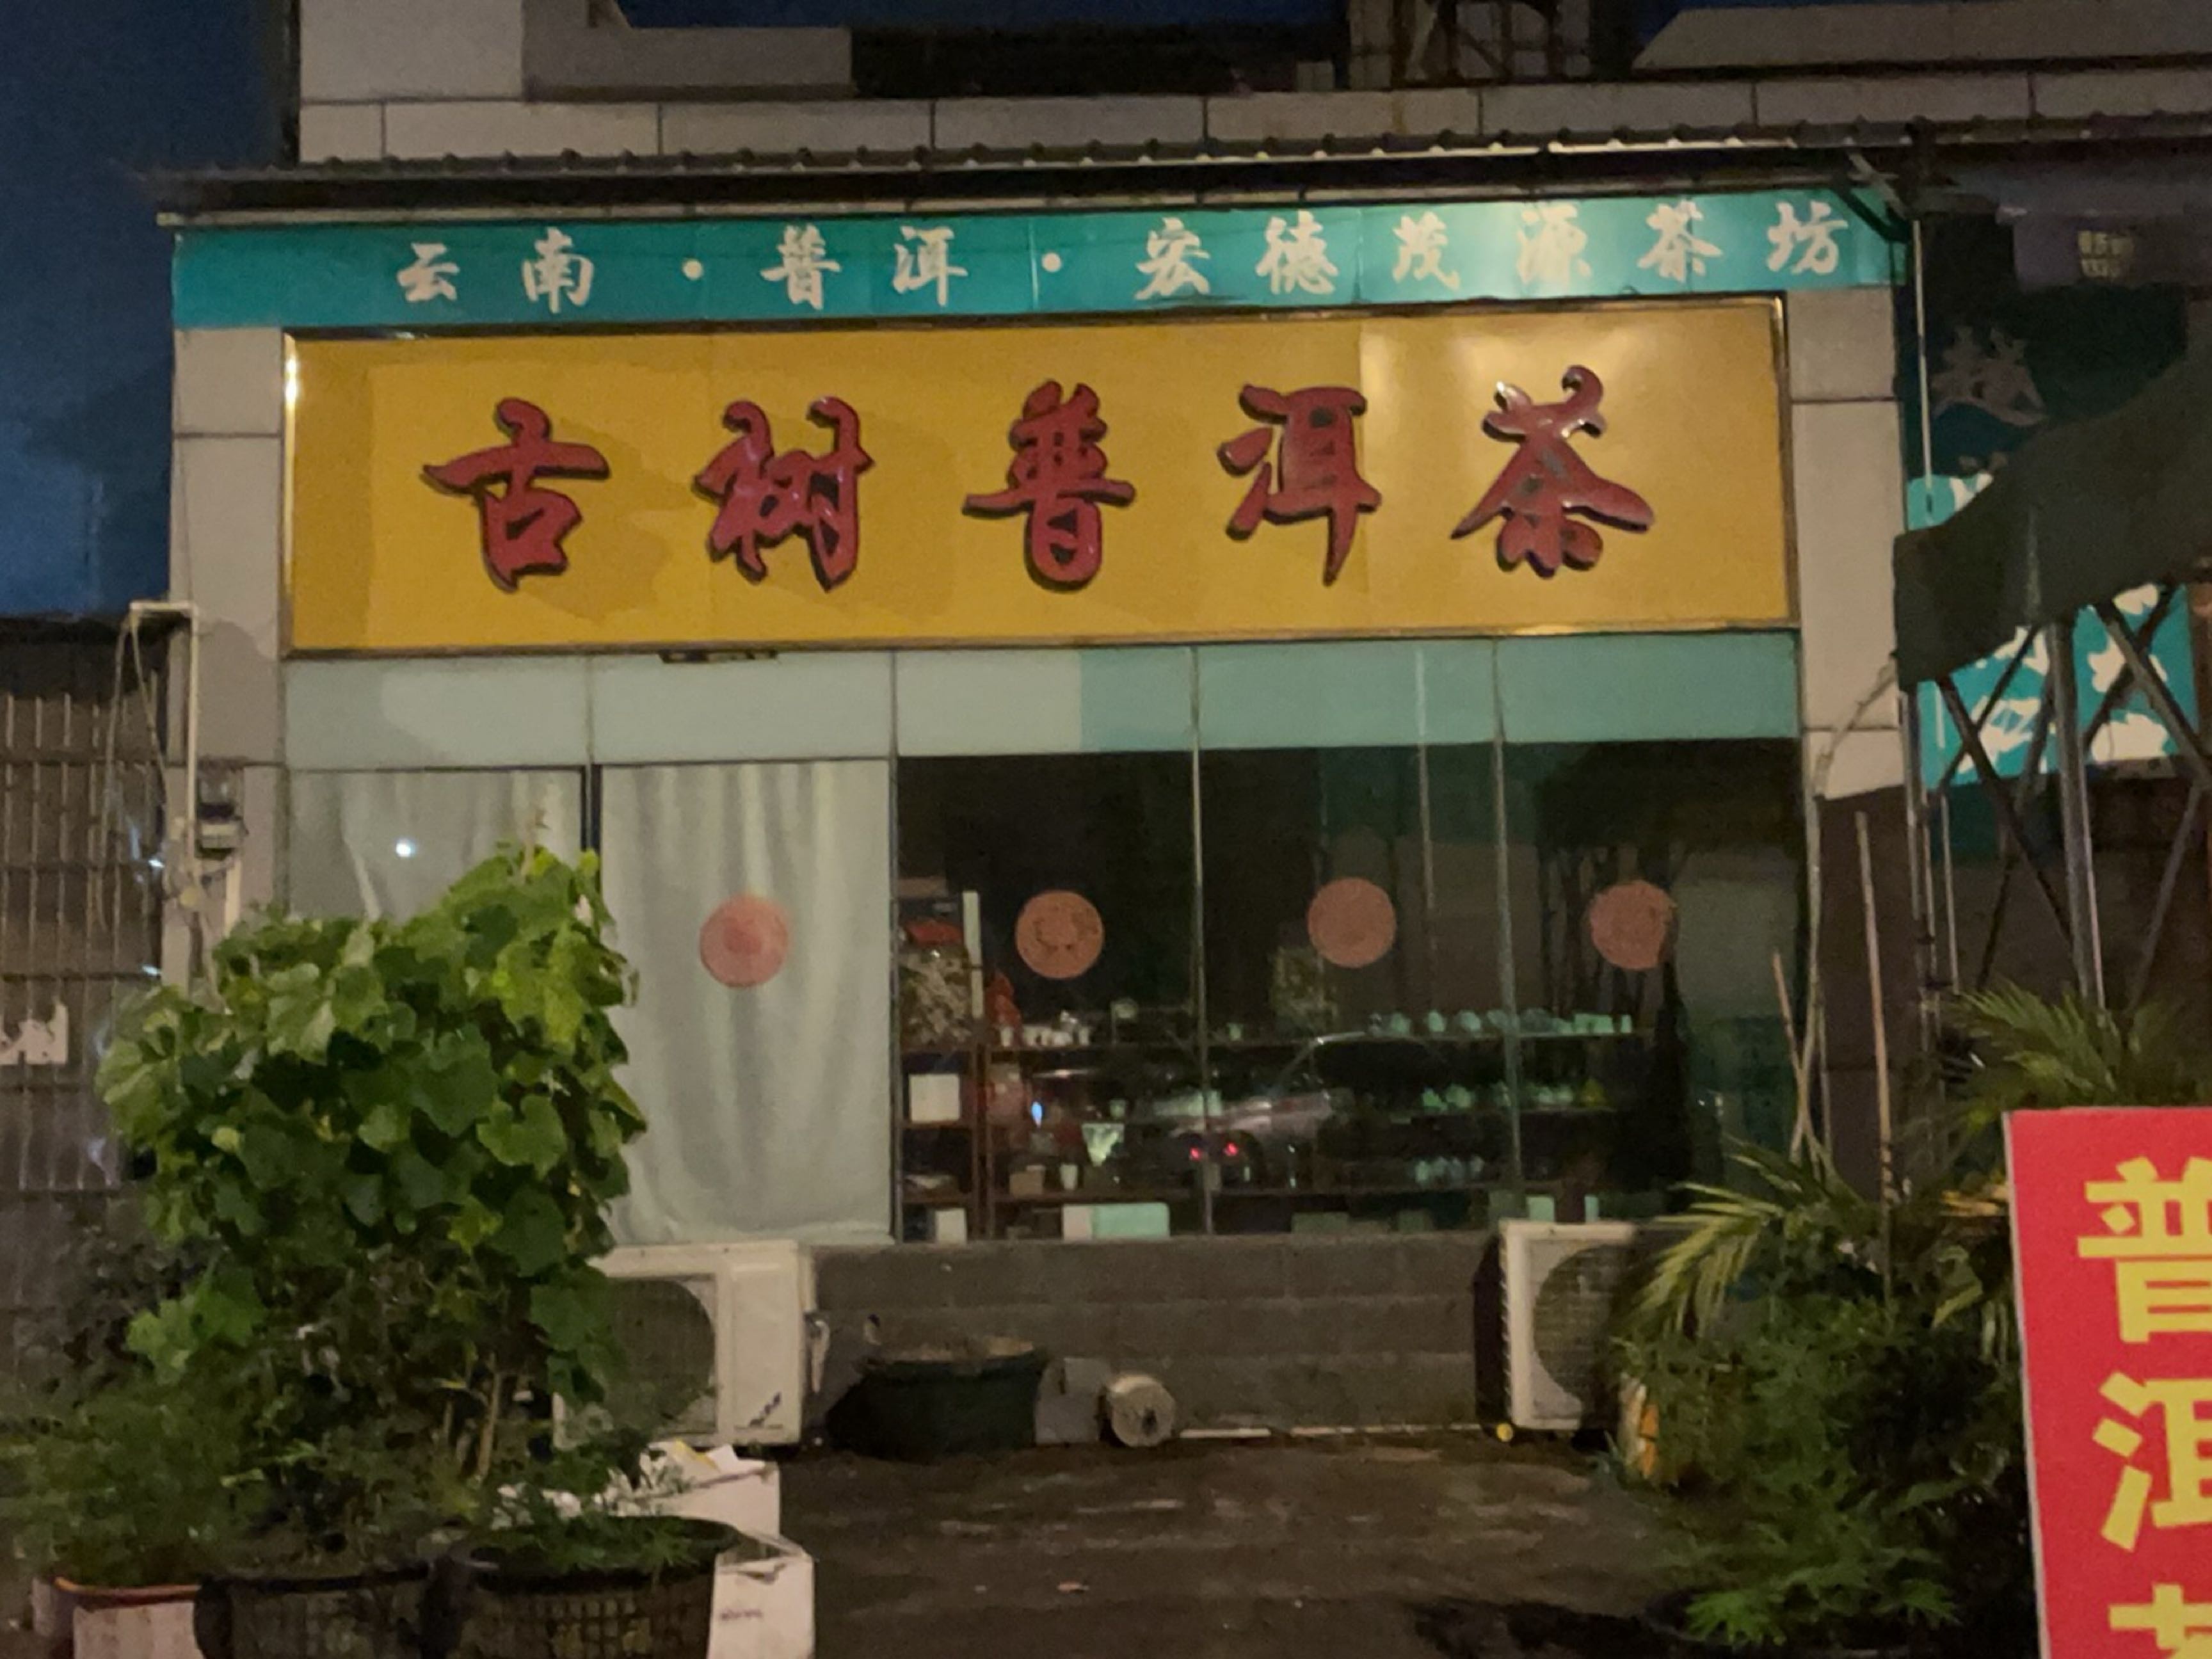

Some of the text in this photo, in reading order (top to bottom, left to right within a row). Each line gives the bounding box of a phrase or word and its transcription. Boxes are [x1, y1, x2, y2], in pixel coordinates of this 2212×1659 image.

[421, 365, 1653, 593] 古树普洱茶
[2077, 1156, 2212, 1659] 普洱
